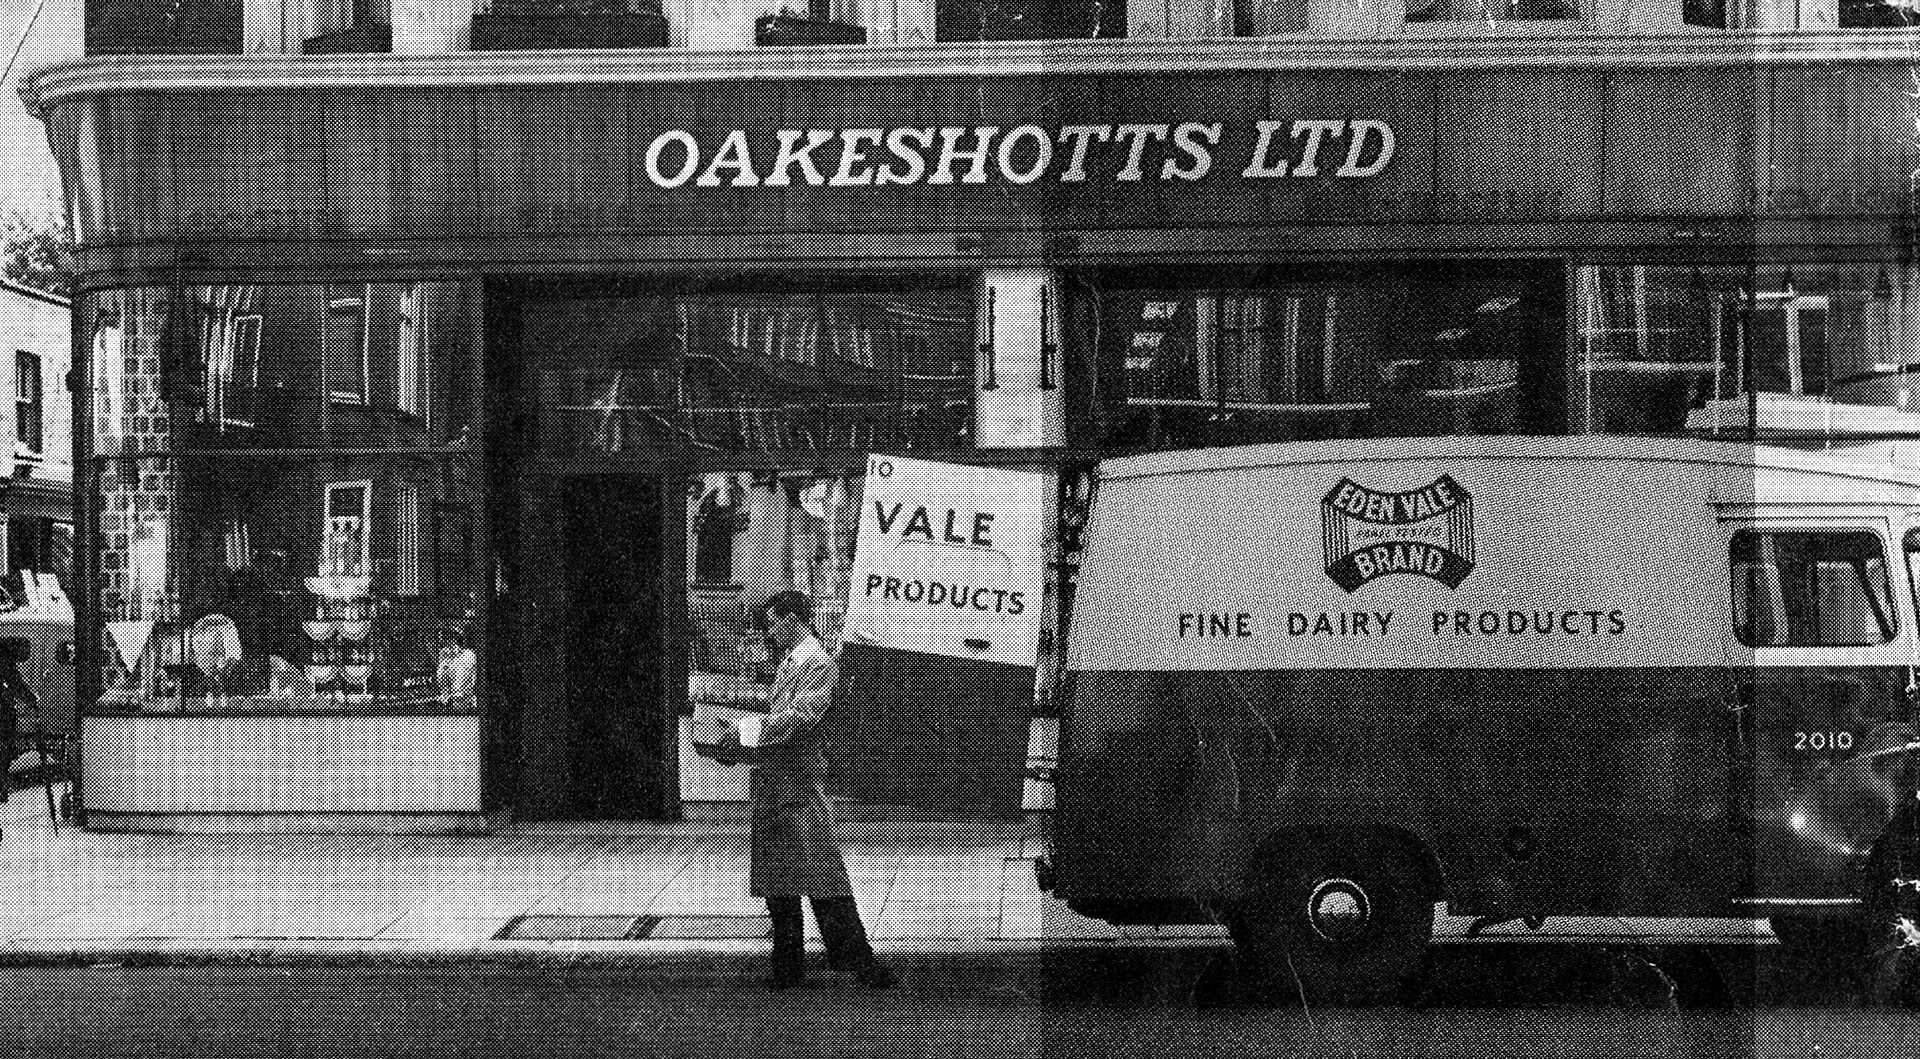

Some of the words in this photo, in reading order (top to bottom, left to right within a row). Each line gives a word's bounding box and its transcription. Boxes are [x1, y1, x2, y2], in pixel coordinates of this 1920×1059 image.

[644, 121, 1221, 188] OAKESHOTTS
[1241, 119, 1396, 180] LTD
[1333, 484, 1395, 521] EDEN
[1400, 483, 1456, 519] VALE
[874, 500, 995, 547] VALE
[1354, 544, 1444, 579] BRAND
[866, 574, 1025, 616] PRODUCTS
[1178, 612, 1252, 638] FINE
[1287, 611, 1395, 637] DAIRY
[1431, 609, 1627, 637] PRODUCTS
[1794, 731, 1853, 750] 2010
